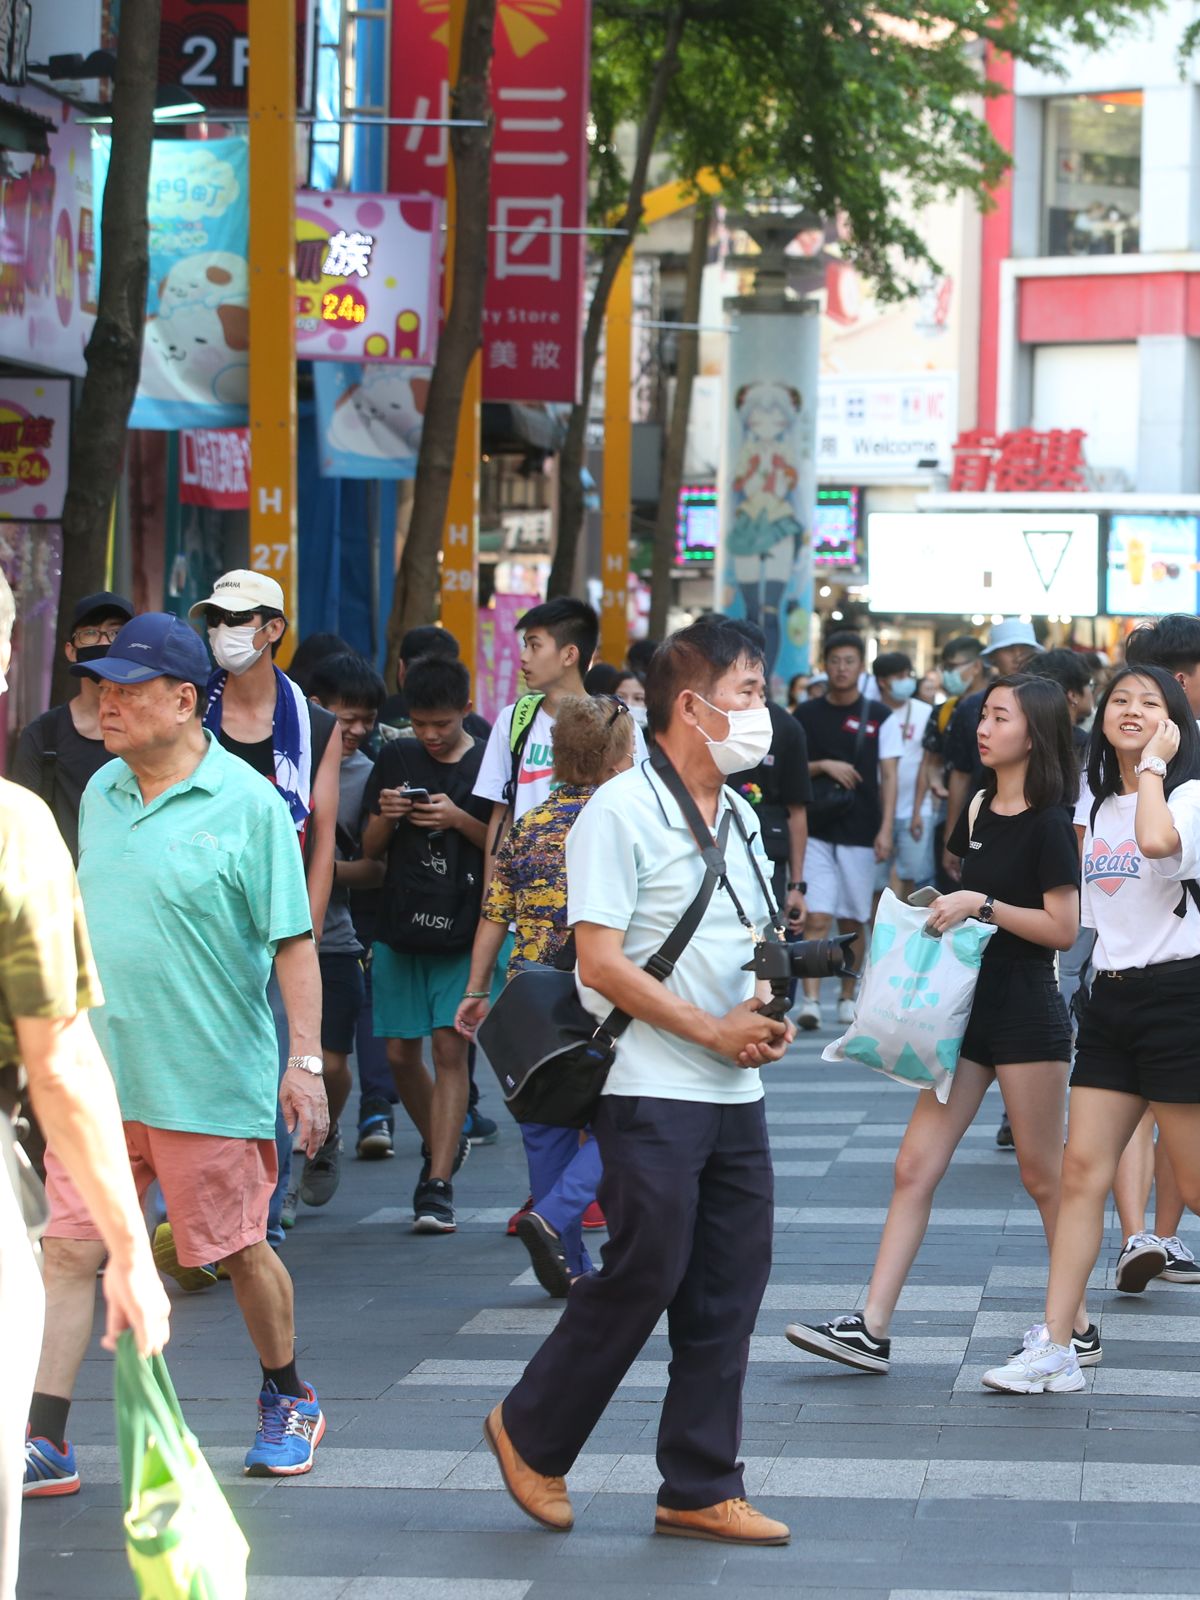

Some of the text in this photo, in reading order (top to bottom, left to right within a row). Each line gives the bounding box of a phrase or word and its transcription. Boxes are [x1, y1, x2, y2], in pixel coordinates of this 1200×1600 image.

[507, 308, 560, 325] Store
[854, 436, 938, 456] Welcome
[258, 486, 283, 515] H
[450, 524, 469, 546] H
[253, 543, 290, 571] 27
